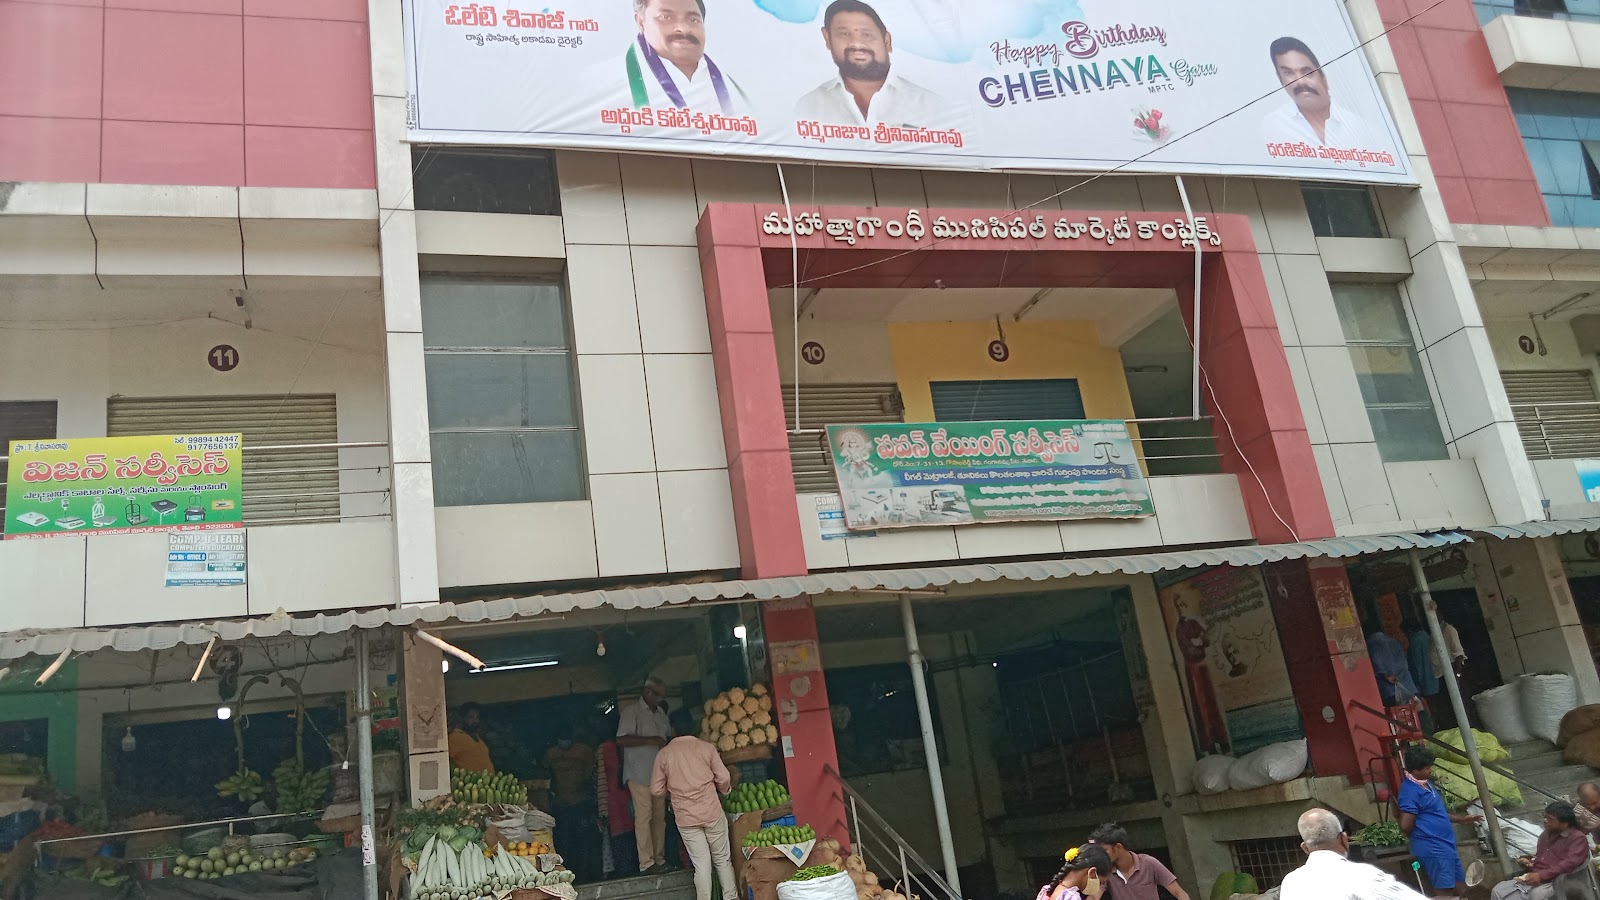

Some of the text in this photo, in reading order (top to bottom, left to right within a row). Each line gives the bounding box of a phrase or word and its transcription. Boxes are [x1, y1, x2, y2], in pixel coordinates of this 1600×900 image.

[445, 3, 599, 32] ఓలేటి శివాజీ గారు
[465, 33, 484, 47] రాష్ట్ర
[485, 33, 520, 46] సాహిత్య
[557, 35, 583, 48] డైరెక్టర్
[990, 20, 1167, 67] Happy Birthday
[978, 54, 1218, 108] CHENNAYA Garu
[1147, 83, 1175, 94] MPTC
[600, 106, 758, 136] అద్దంకి కోటేశ్వరరావు
[796, 120, 963, 148] ధర్మరాజుల శ్రీనివాసరావు
[932, 214, 1048, 240] మునిసిపల్
[1053, 216, 1132, 245] మార్కెట్
[212, 349, 234, 366] 11
[803, 346, 824, 361] 10
[992, 343, 1005, 360] 9
[1521, 339, 1531, 352] 7
[188, 436, 213, 444] 99894
[874, 430, 930, 459] పవన్
[930, 427, 1011, 457] వేయింగ్
[1009, 427, 1081, 464] సర్వీసెస్
[22, 451, 230, 485] విజన్ సర్వీసెస్
